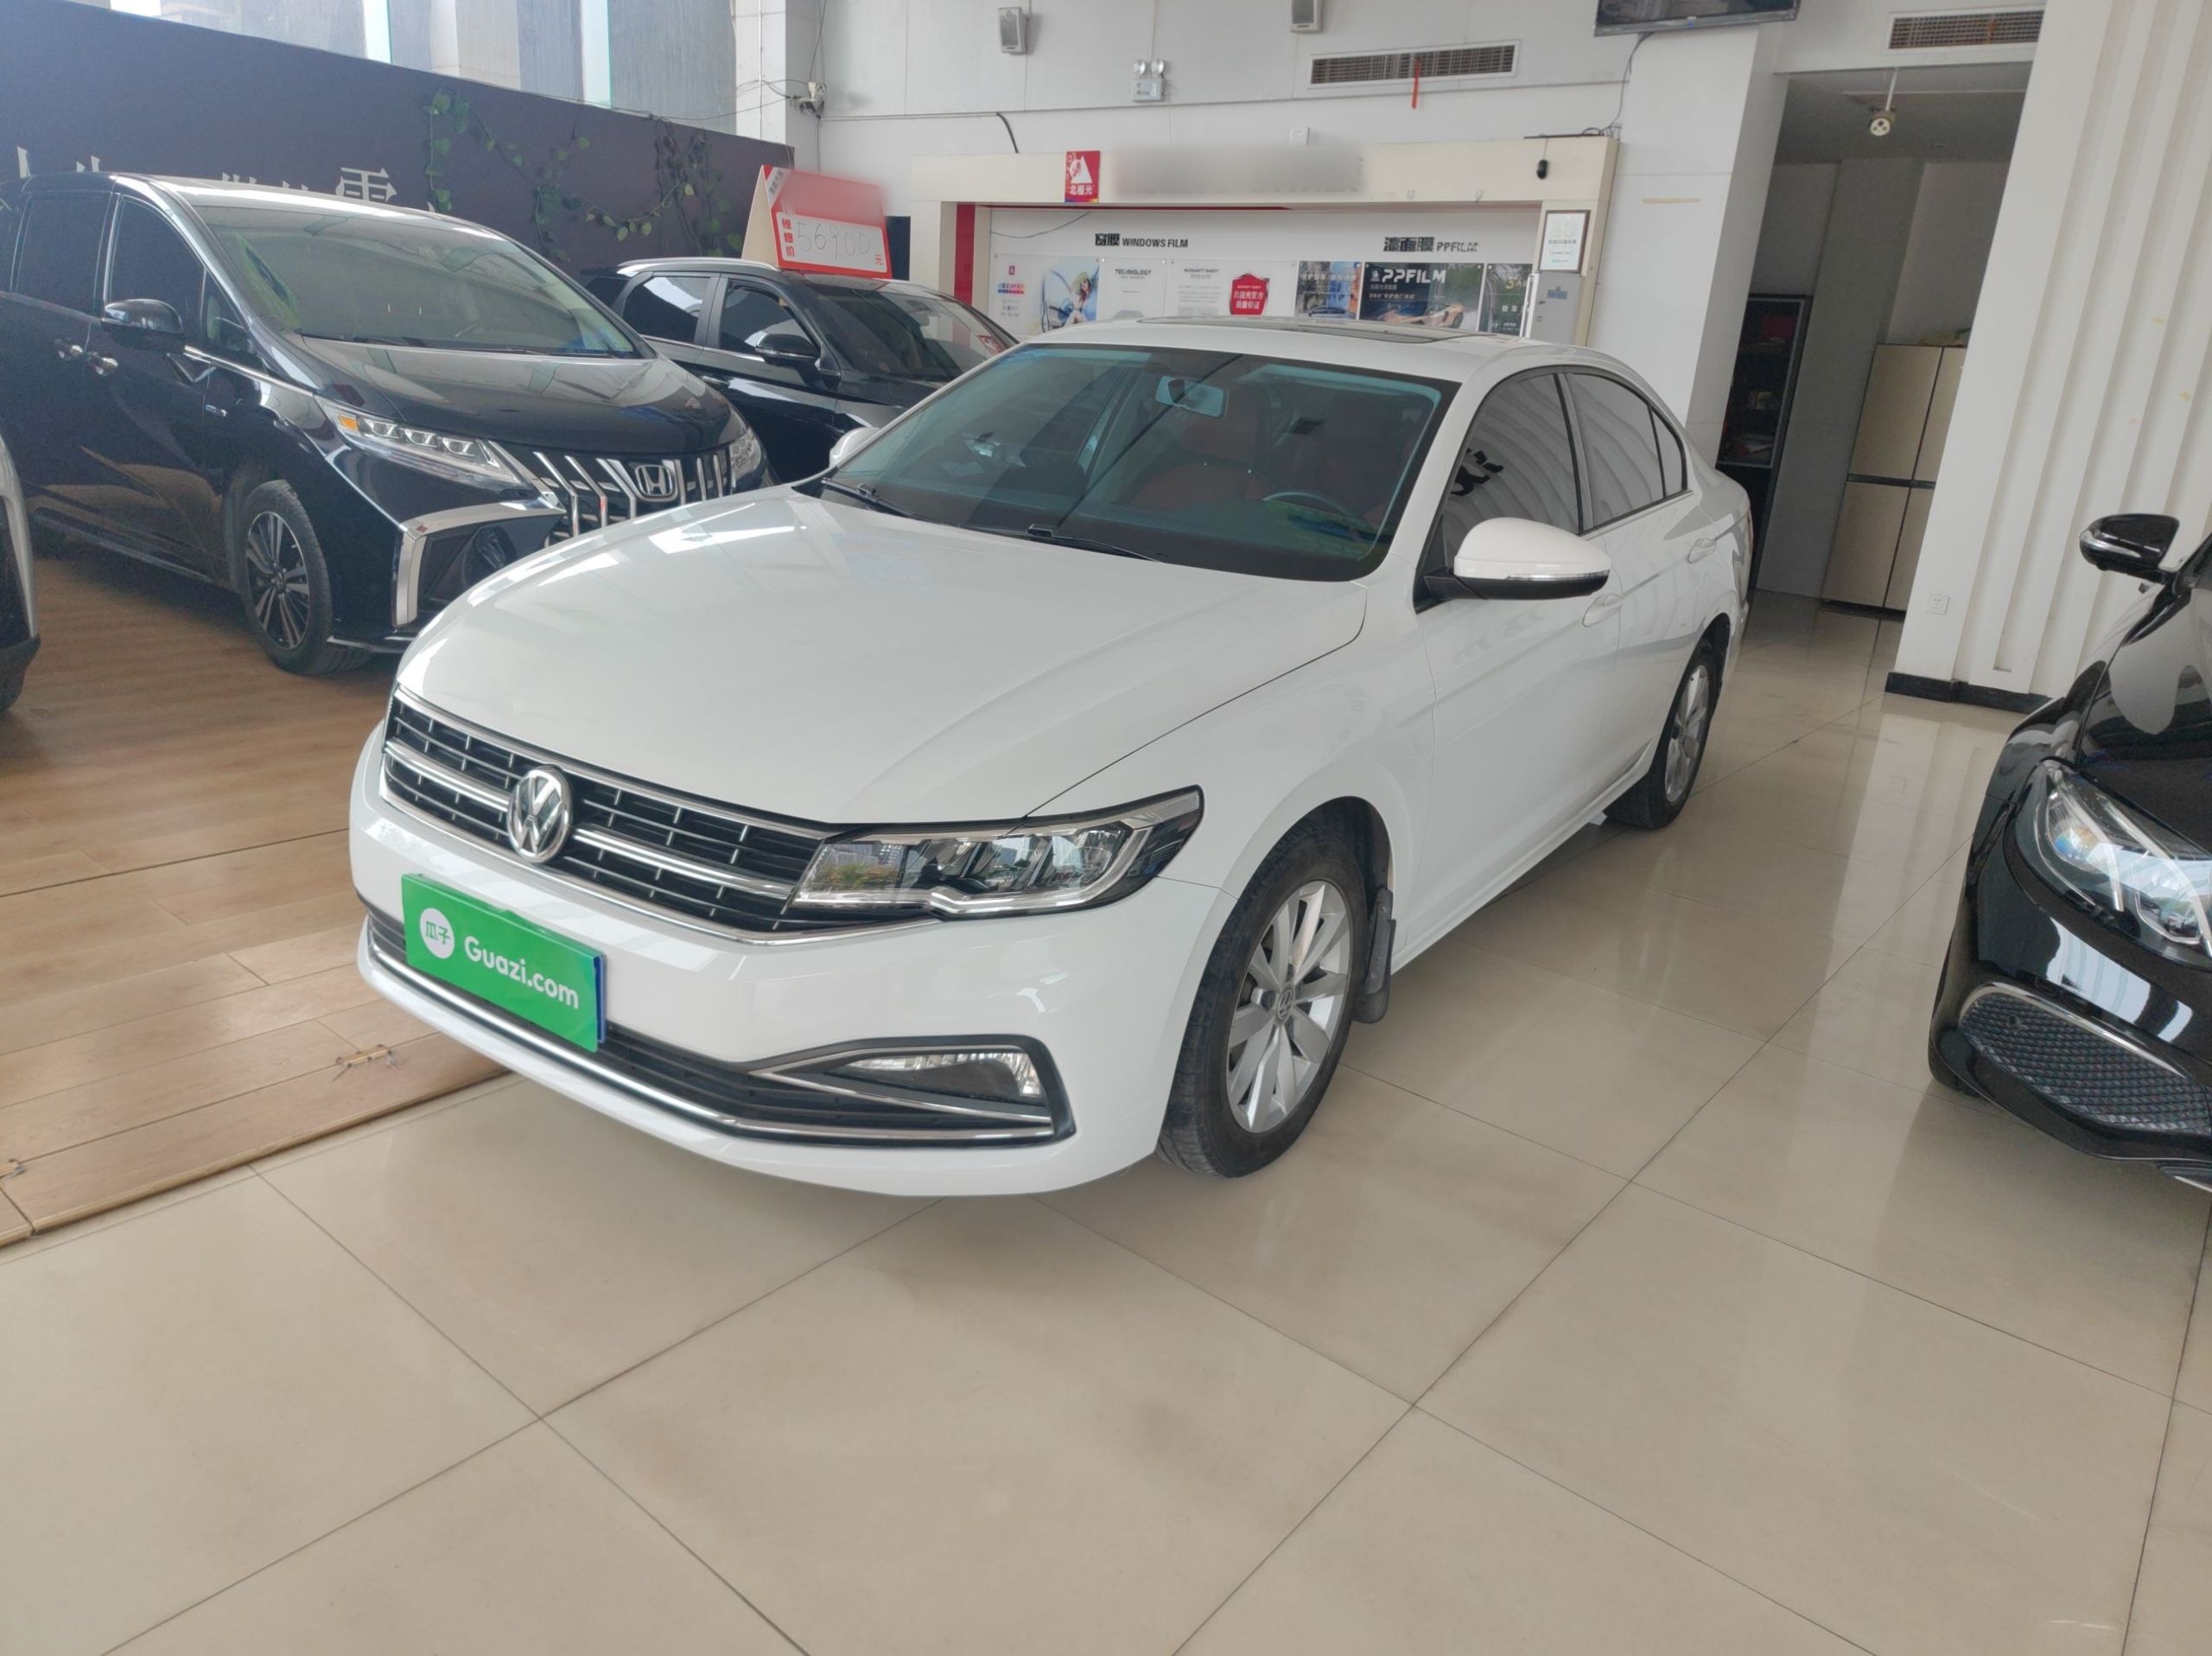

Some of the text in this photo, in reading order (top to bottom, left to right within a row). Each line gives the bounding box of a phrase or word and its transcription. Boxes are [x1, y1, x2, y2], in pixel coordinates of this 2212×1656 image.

[1122, 238, 1188, 248] WINDOWS FILM
[874, 254, 884, 265] 元
[463, 935, 580, 1010] Guazi.com
